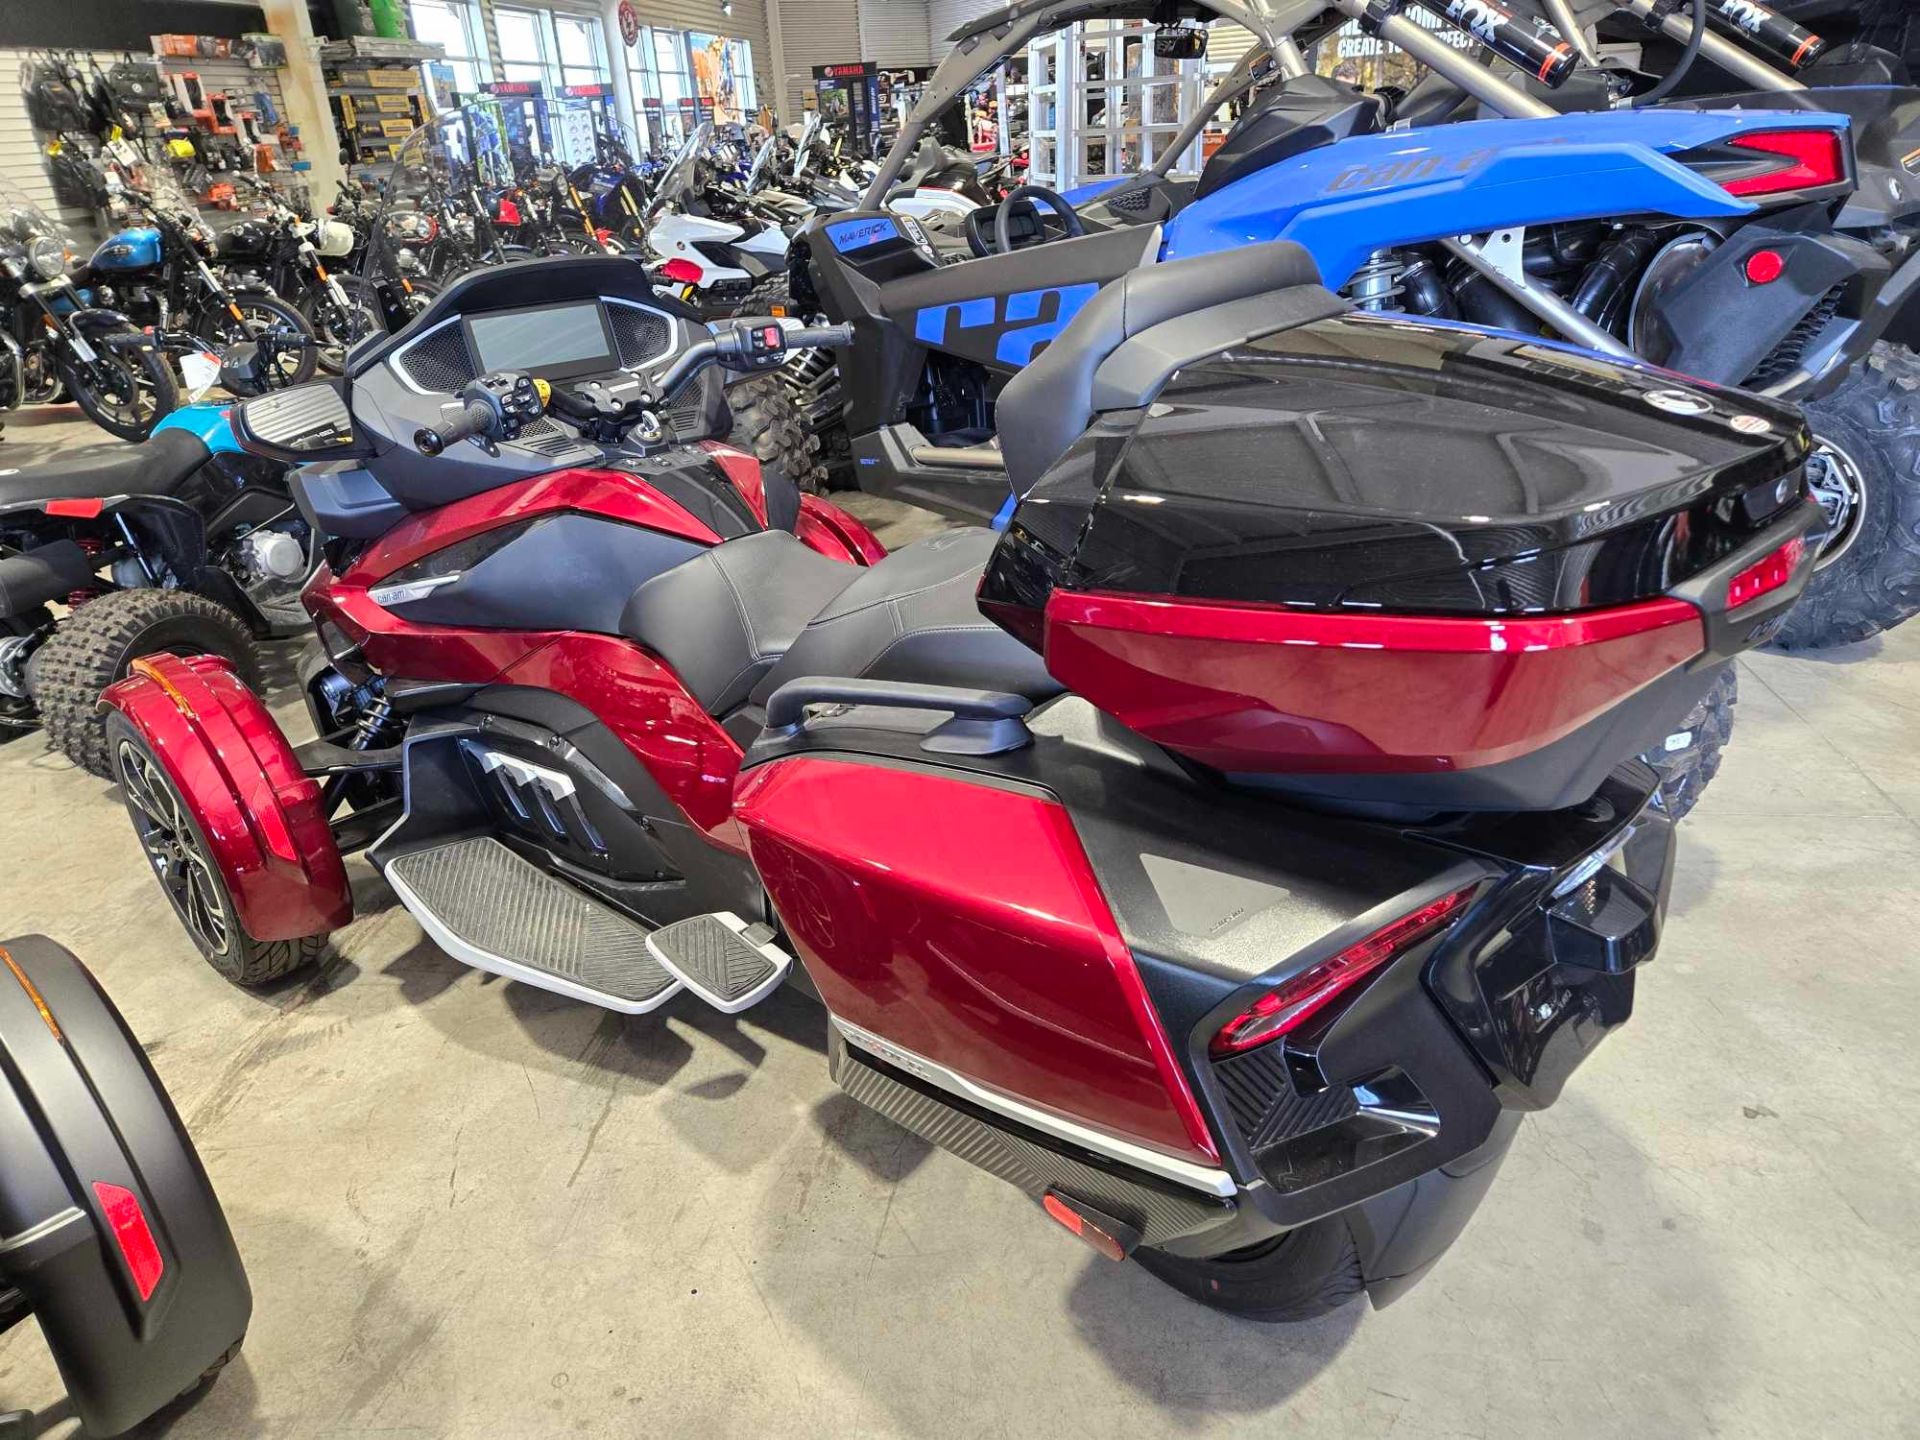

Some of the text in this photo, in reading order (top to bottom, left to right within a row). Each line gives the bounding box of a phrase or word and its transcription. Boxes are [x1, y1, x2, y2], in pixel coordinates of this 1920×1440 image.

[1446, 0, 1510, 43] FOX
[1718, 0, 1773, 33] FOX
[1337, 37, 1383, 58] CREATE
[833, 64, 865, 77] YAMAHA
[839, 222, 888, 246] MAVERICK
